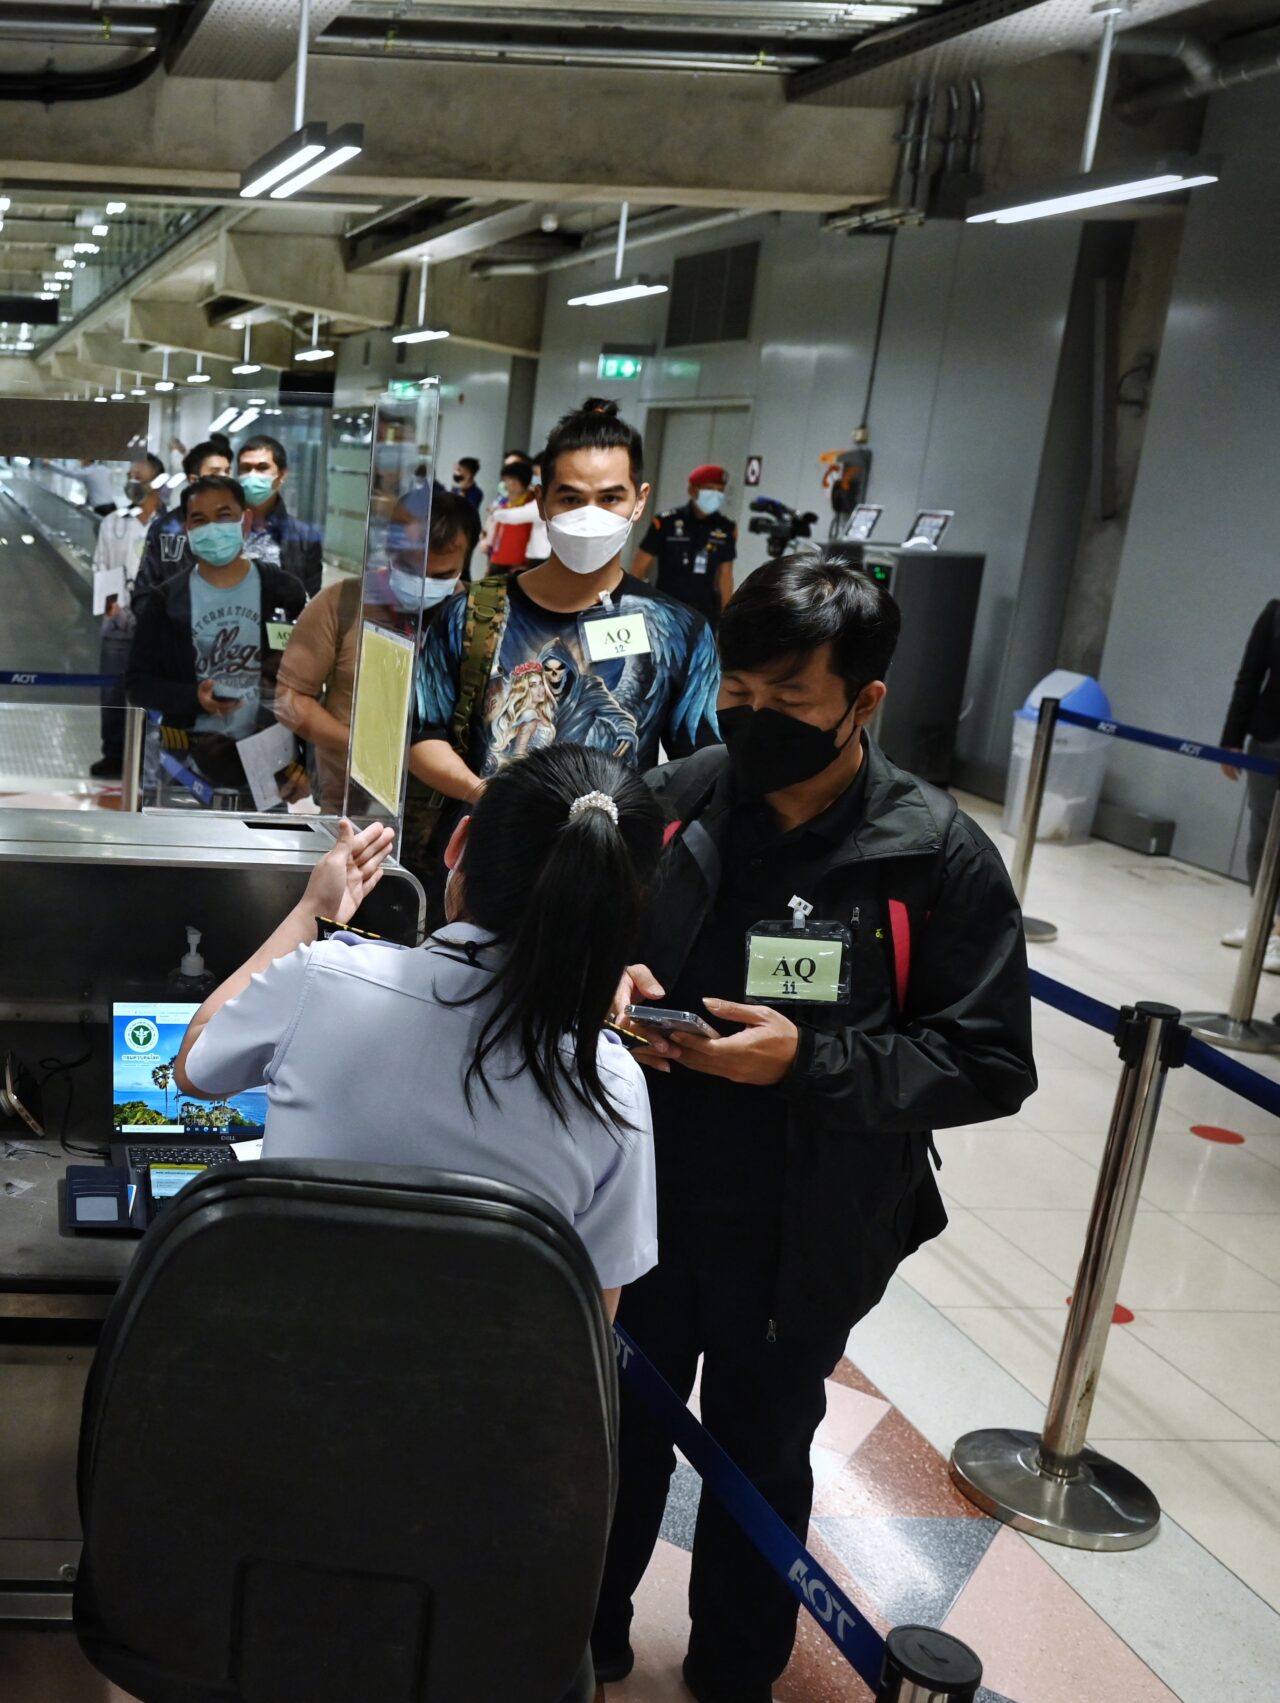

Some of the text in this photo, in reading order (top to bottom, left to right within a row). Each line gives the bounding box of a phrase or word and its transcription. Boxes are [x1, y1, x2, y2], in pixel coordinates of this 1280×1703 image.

[604, 628, 631, 645] AQ
[614, 645, 626, 653] 12
[11, 674, 37, 684] AOT
[771, 956, 816, 983] AQ
[787, 1558, 856, 1642] AOT
